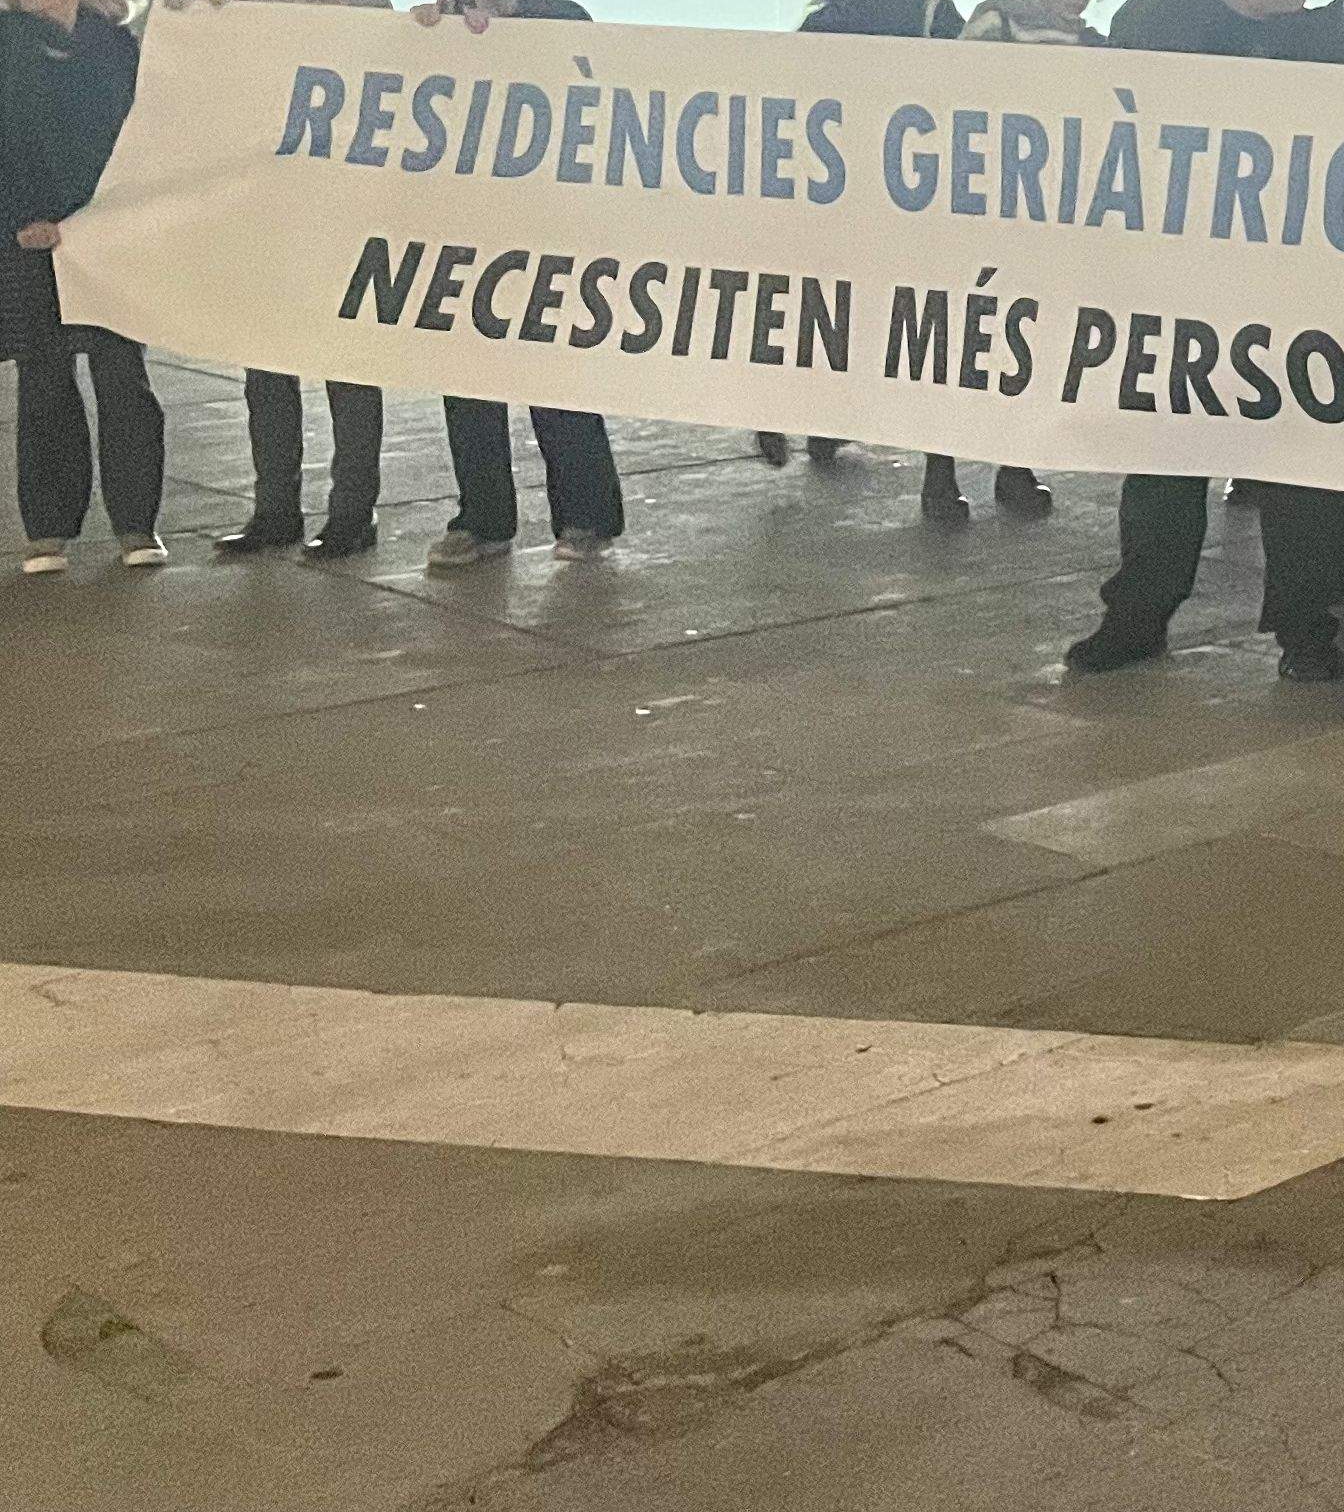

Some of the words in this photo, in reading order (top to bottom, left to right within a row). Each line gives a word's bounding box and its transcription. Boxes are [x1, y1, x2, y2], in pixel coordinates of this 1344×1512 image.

[276, 56, 848, 206] RESIDÈNCIES
[338, 236, 852, 373] NECESSITEN
[884, 267, 1039, 397] MÉS
